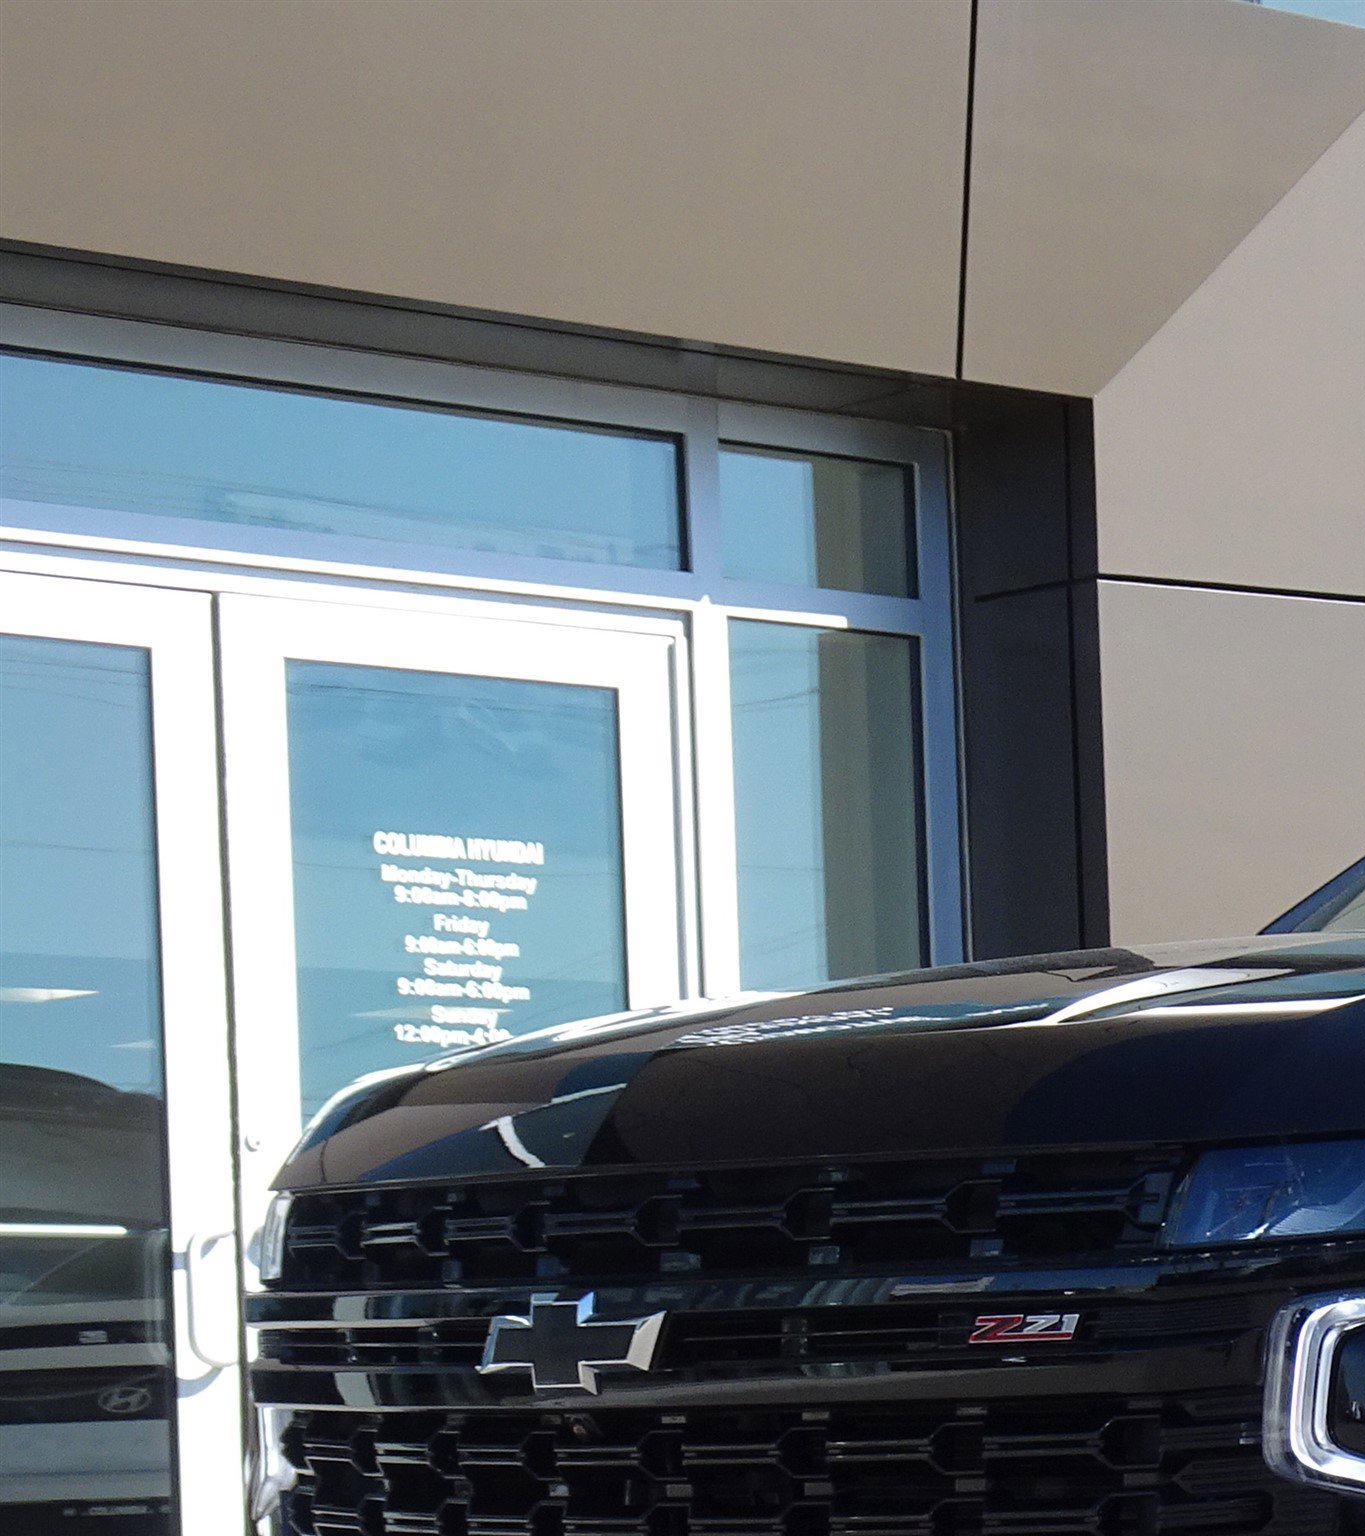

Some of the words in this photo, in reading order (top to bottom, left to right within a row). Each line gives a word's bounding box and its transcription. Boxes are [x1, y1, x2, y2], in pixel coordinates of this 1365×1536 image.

[373, 831, 467, 860] COLUMBIA
[467, 838, 544, 865] HYUNDAI
[381, 864, 537, 895] Monday-Thursday
[433, 913, 490, 938] Friday
[423, 957, 503, 982] Saturday
[431, 1005, 498, 1029] Sunday
[969, 1313, 1080, 1344] Z71
